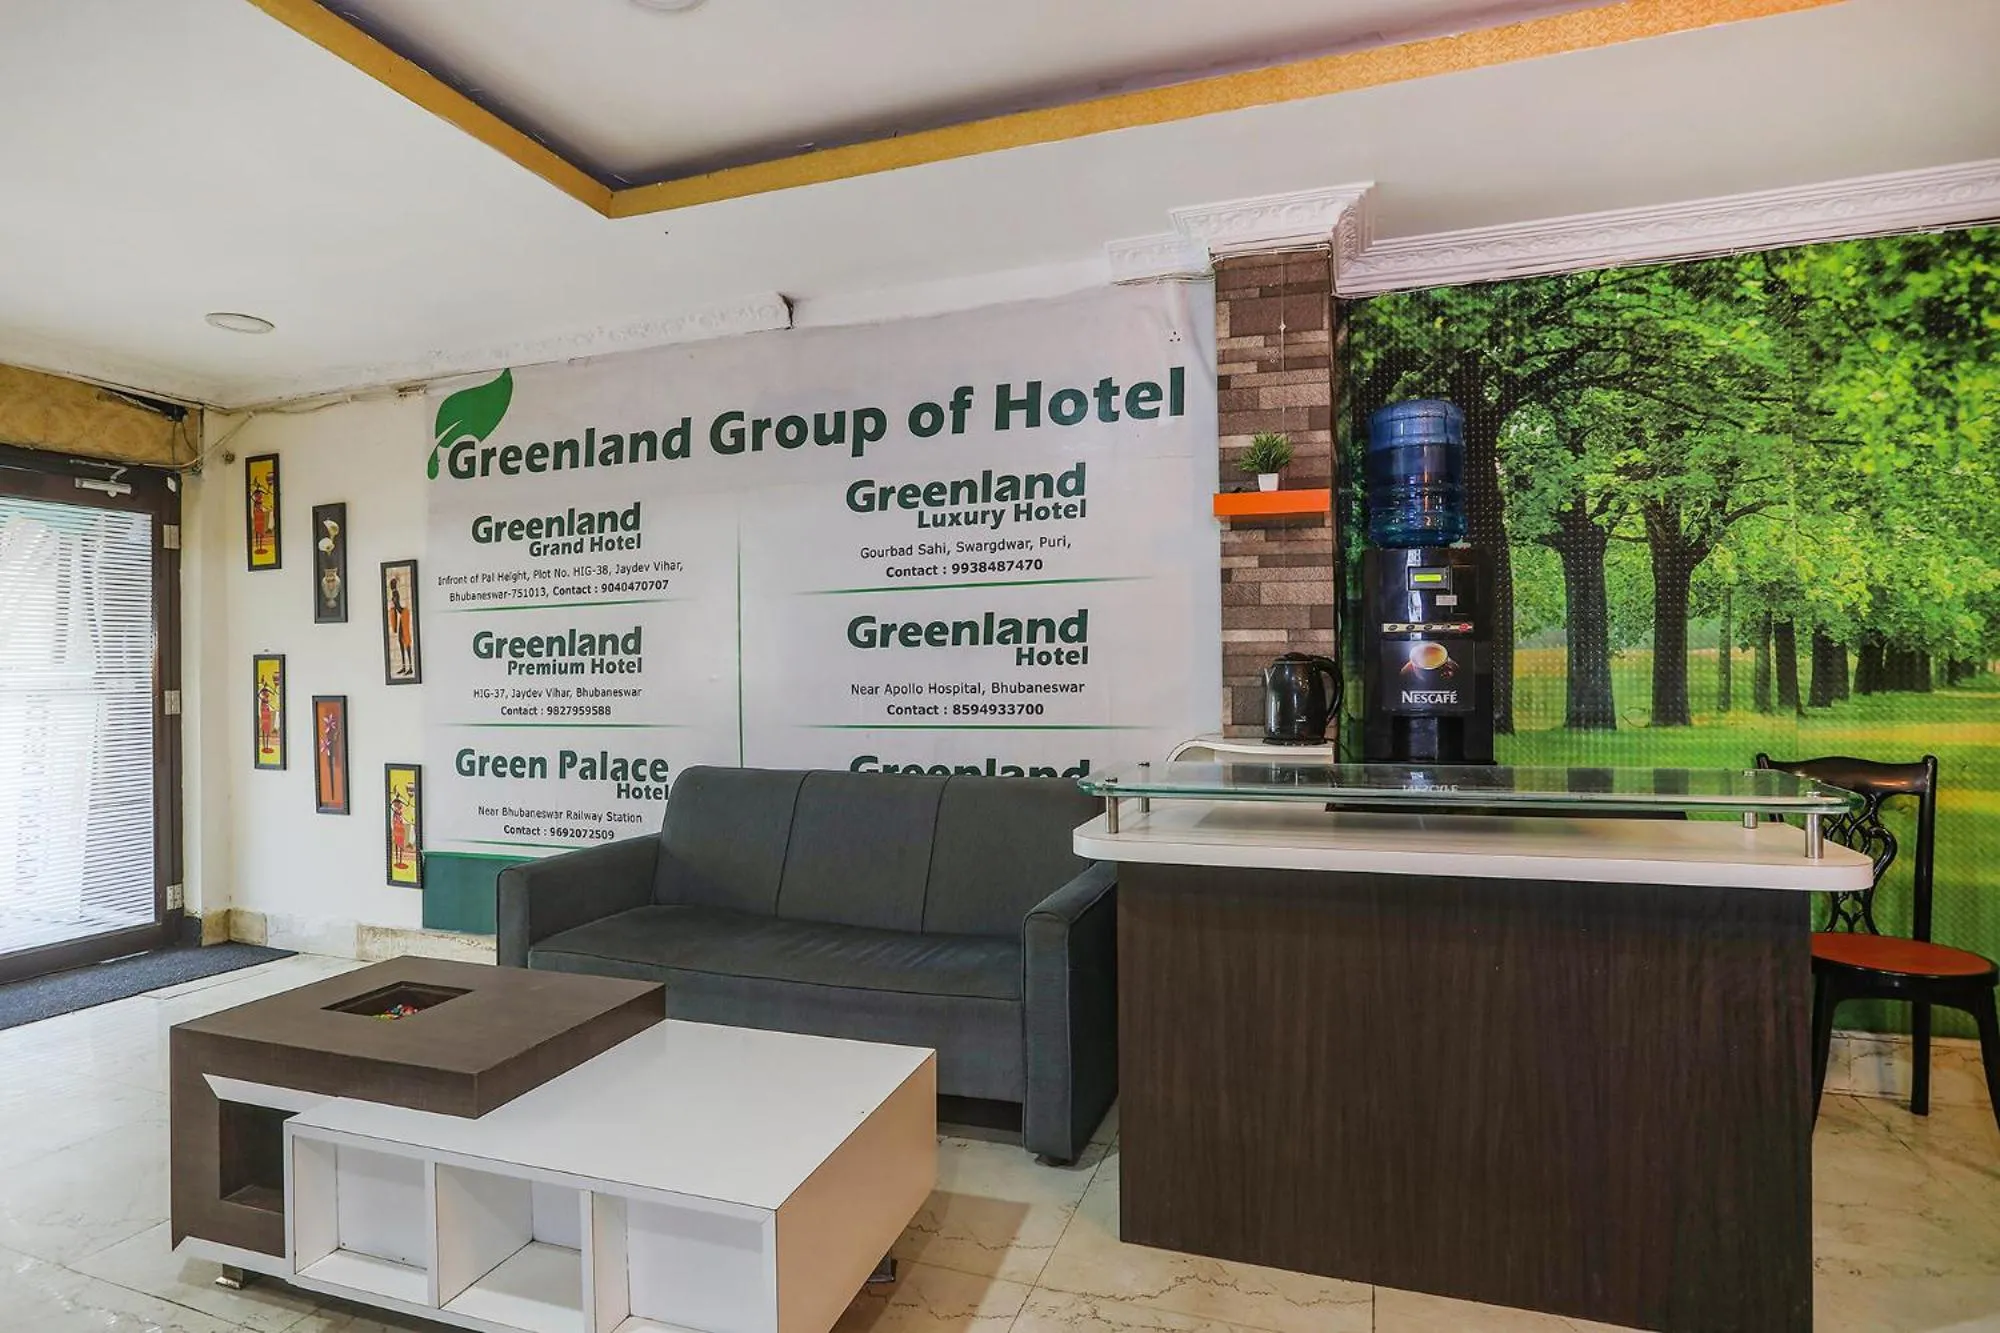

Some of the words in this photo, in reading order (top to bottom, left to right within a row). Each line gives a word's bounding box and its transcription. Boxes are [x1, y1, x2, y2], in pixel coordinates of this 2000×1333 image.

[448, 417, 692, 480] Greenland
[709, 407, 887, 458] Group
[907, 386, 974, 438] of
[994, 366, 1185, 432] Hotel
[846, 462, 1087, 513] Greenland
[471, 501, 641, 544] Greenland
[917, 507, 1006, 530] Luxury
[1013, 499, 1087, 523] Hotel
[528, 538, 584, 557] Grand
[590, 533, 642, 553] Hotel
[860, 543, 913, 559] Gourbad
[918, 542, 951, 556] Sahi,
[956, 537, 1033, 554] Swargdwar,
[1039, 535, 1071, 550] Puri,
[470, 573, 479, 584] of
[481, 572, 494, 583] Pal
[497, 570, 530, 584] Height,
[533, 569, 550, 580] Plot
[554, 568, 570, 579] No.
[573, 565, 612, 577] HIG-38,
[615, 562, 650, 575] Jaydev
[653, 560, 683, 573] Vihar,
[886, 564, 938, 578] Contact
[942, 566, 946, 575] :
[951, 559, 1043, 575] 9938487470
[450, 587, 549, 602] Bhubaneswar-751013,
[552, 585, 592, 596] Contact
[600, 580, 669, 592] 9040470707
[847, 609, 1089, 648] Greenland
[472, 626, 642, 659] Greenland
[507, 660, 585, 676] Premium
[591, 657, 642, 674] Hotel
[1015, 646, 1089, 666] Hotel
[473, 688, 508, 699] HIG-37,
[511, 688, 543, 700] Jaydev
[545, 688, 573, 699] Vihar,
[576, 687, 642, 698] Bhubaneswar
[851, 683, 880, 696] Near
[884, 682, 924, 697] Apollo
[928, 682, 985, 697] Hospital,
[991, 681, 1085, 694] Bhubaneswar
[1401, 690, 1458, 704] NESCAFÉ
[501, 706, 538, 716] Contact
[547, 706, 611, 716] 9827959588
[887, 704, 939, 716] Contact
[943, 706, 948, 715] :
[952, 704, 1044, 716] 8594933700
[455, 748, 547, 779] Green
[559, 750, 669, 783] Palace
[616, 783, 669, 801] Hotel
[478, 806, 499, 817] Near
[502, 807, 563, 820] Bhubaneswar
[566, 810, 602, 823] Railway
[606, 811, 642, 823] Station
[503, 825, 540, 836] Contact
[550, 827, 614, 840] 9692072509
